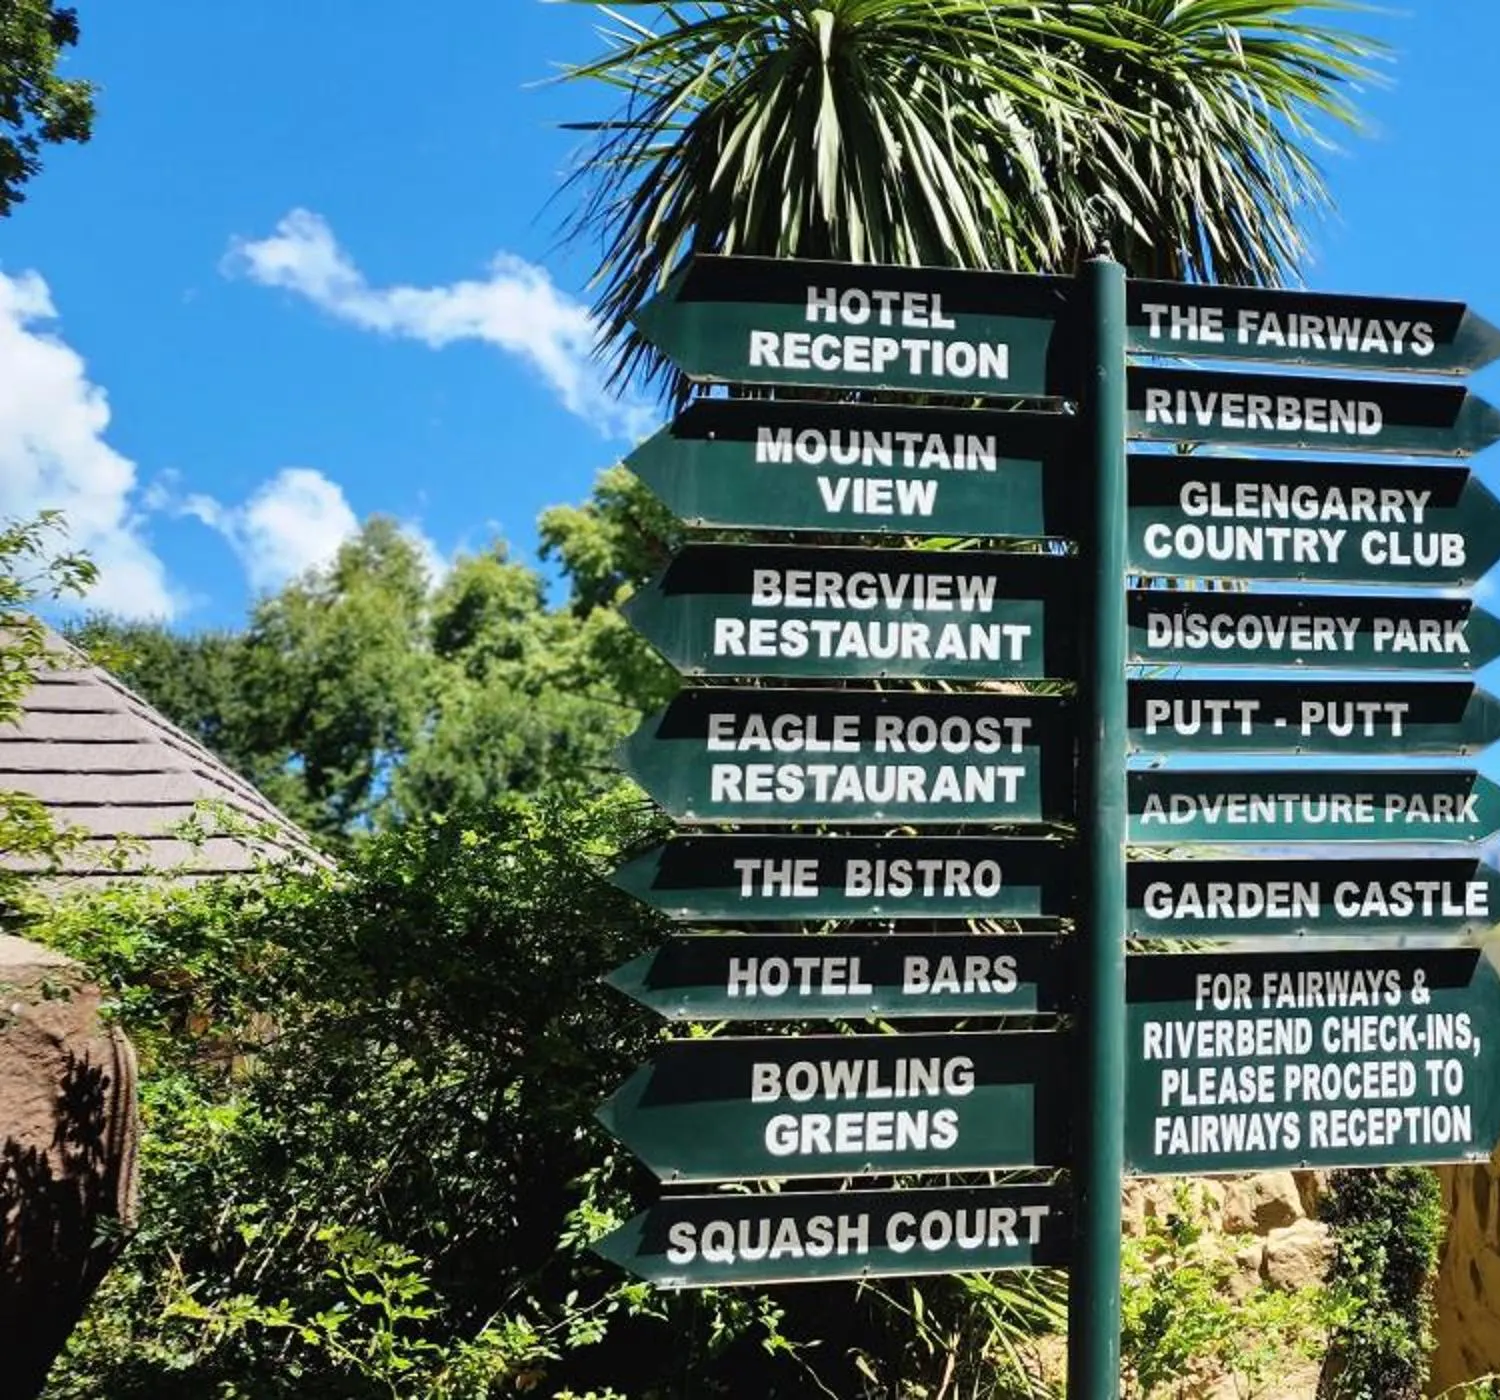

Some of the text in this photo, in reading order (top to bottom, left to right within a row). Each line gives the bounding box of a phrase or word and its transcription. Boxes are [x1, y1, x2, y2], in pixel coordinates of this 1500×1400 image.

[806, 286, 955, 329] HOTEL
[1141, 304, 1436, 357] THE FAIRWAYS
[749, 330, 1009, 379] RECEPTION
[1144, 388, 1383, 436] RIVERBEND
[755, 426, 997, 472] MOUNTAIN
[817, 476, 938, 517] VIEW
[1179, 481, 1431, 525] GLENGARRY
[1143, 523, 1466, 567] COUNTRY CLUB
[752, 568, 998, 612] BERGVIEW
[713, 618, 1031, 661] RESTAURANT
[1147, 613, 1471, 653] DISCOVERY PARK
[707, 713, 1032, 755] EAGLE ROOST
[1145, 699, 1409, 737] PUTT - PUTT
[710, 763, 1025, 805] RESTAURANT
[1140, 794, 1480, 826] ADVENTURE PARK
[734, 859, 1002, 898] THE BISTRO
[1143, 881, 1489, 919] GARDEN CASTLE
[727, 955, 1018, 997] HOTEL BARS
[1195, 968, 1431, 1011] FOR FAIRWAYS &
[1143, 1013, 1481, 1060] RIVERBEND CHECK-INS,
[751, 1057, 975, 1103] BOWLING
[1161, 1058, 1464, 1106] PLEASE PROCEED TO
[764, 1108, 960, 1156] GREENS
[1153, 1105, 1472, 1155] FAIRWAYS RECEPTION
[666, 1206, 1050, 1266] SQUASH COURT
